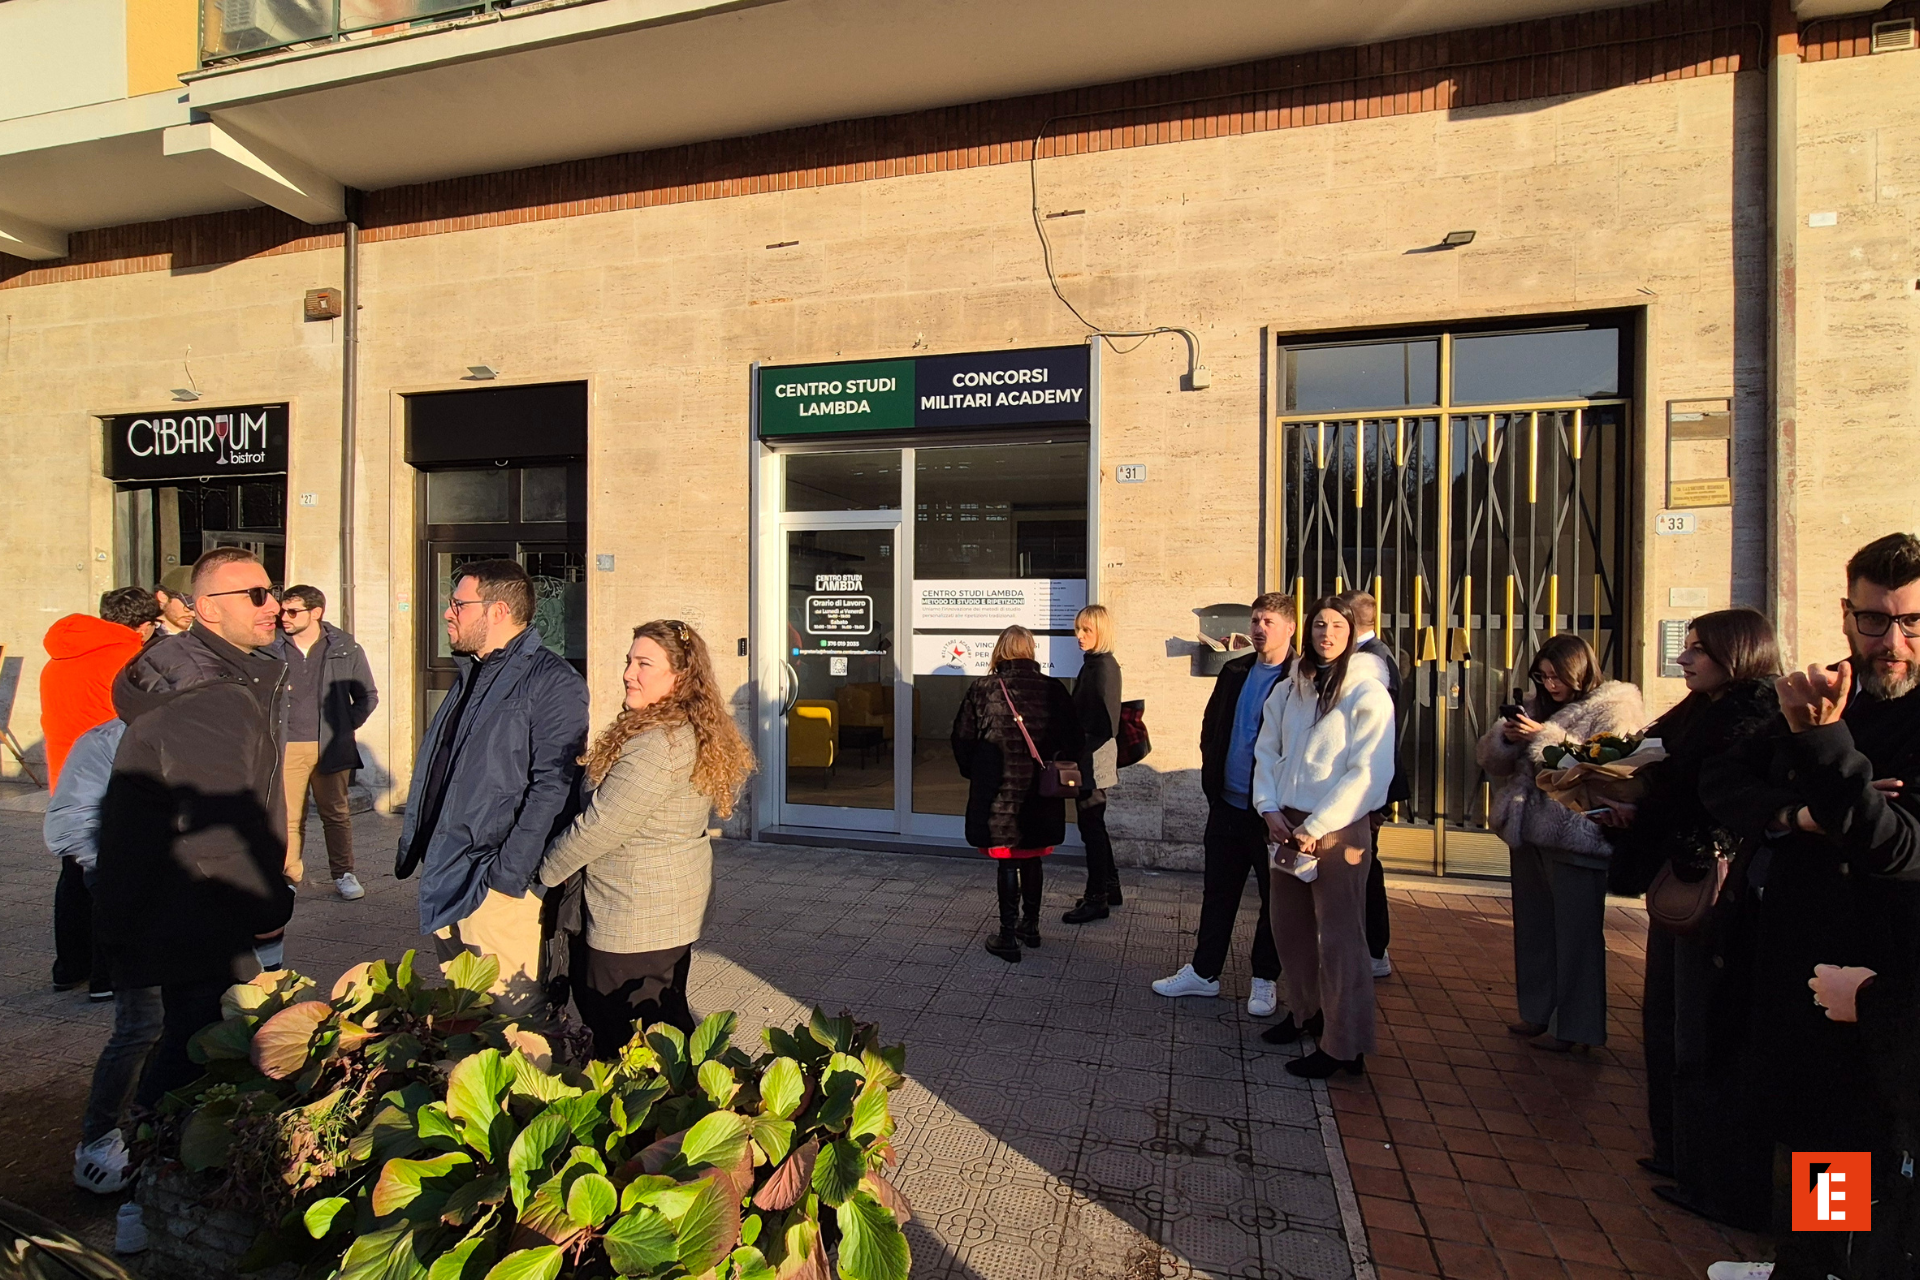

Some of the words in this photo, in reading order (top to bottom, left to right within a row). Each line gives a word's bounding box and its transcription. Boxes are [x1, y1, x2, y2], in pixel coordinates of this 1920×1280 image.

[952, 368, 1048, 387] CONCORSI
[775, 381, 842, 398] CENTRO
[846, 377, 896, 393] STUDI
[921, 393, 991, 410] MILITARI
[995, 388, 1083, 406] ACADEMY
[799, 400, 871, 416] LAMBDA
[230, 451, 265, 464] bistrot
[1125, 467, 1136, 479] 31
[304, 494, 312, 504] 27
[1668, 517, 1684, 530] 33
[815, 581, 863, 591] LAMBDA
[843, 599, 866, 607] Lavoro
